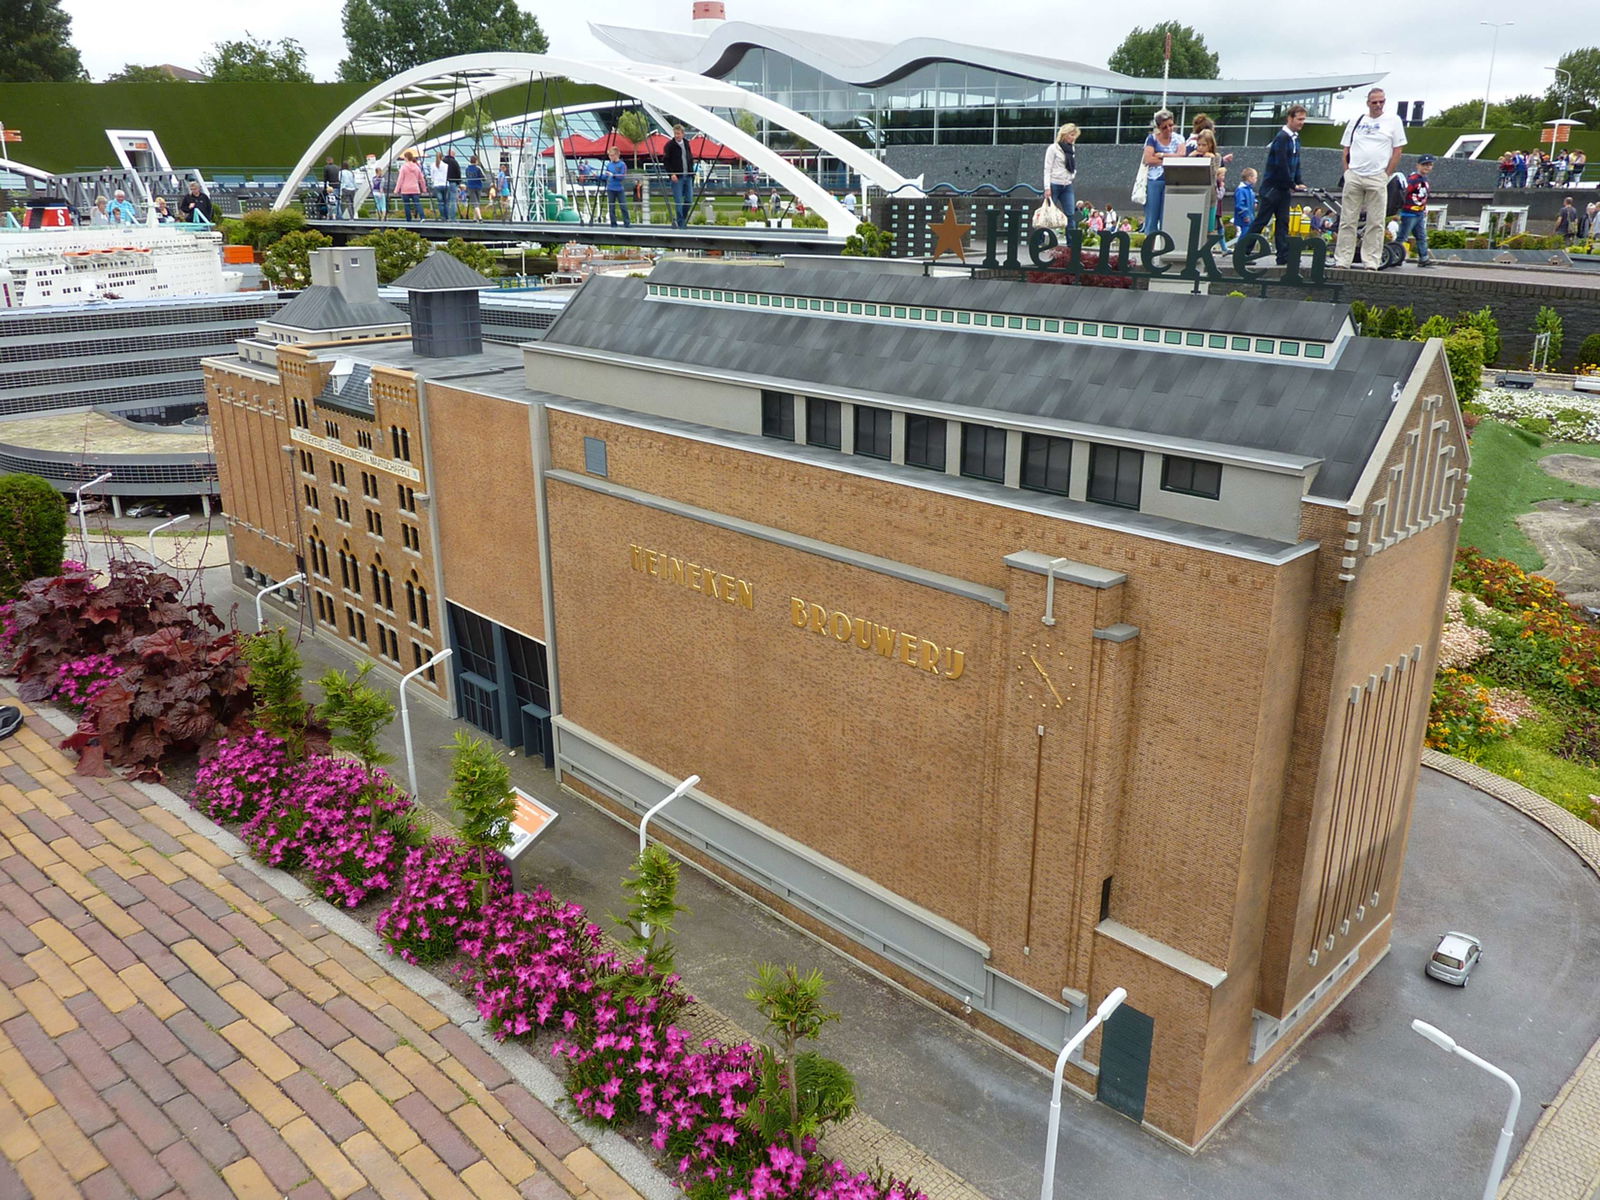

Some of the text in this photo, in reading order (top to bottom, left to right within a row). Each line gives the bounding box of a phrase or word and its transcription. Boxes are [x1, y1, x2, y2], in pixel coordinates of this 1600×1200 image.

[57, 209, 66, 226] S
[983, 208, 1329, 283] Heineken
[630, 543, 965, 680] HEINEKEN BROUWERIJ
